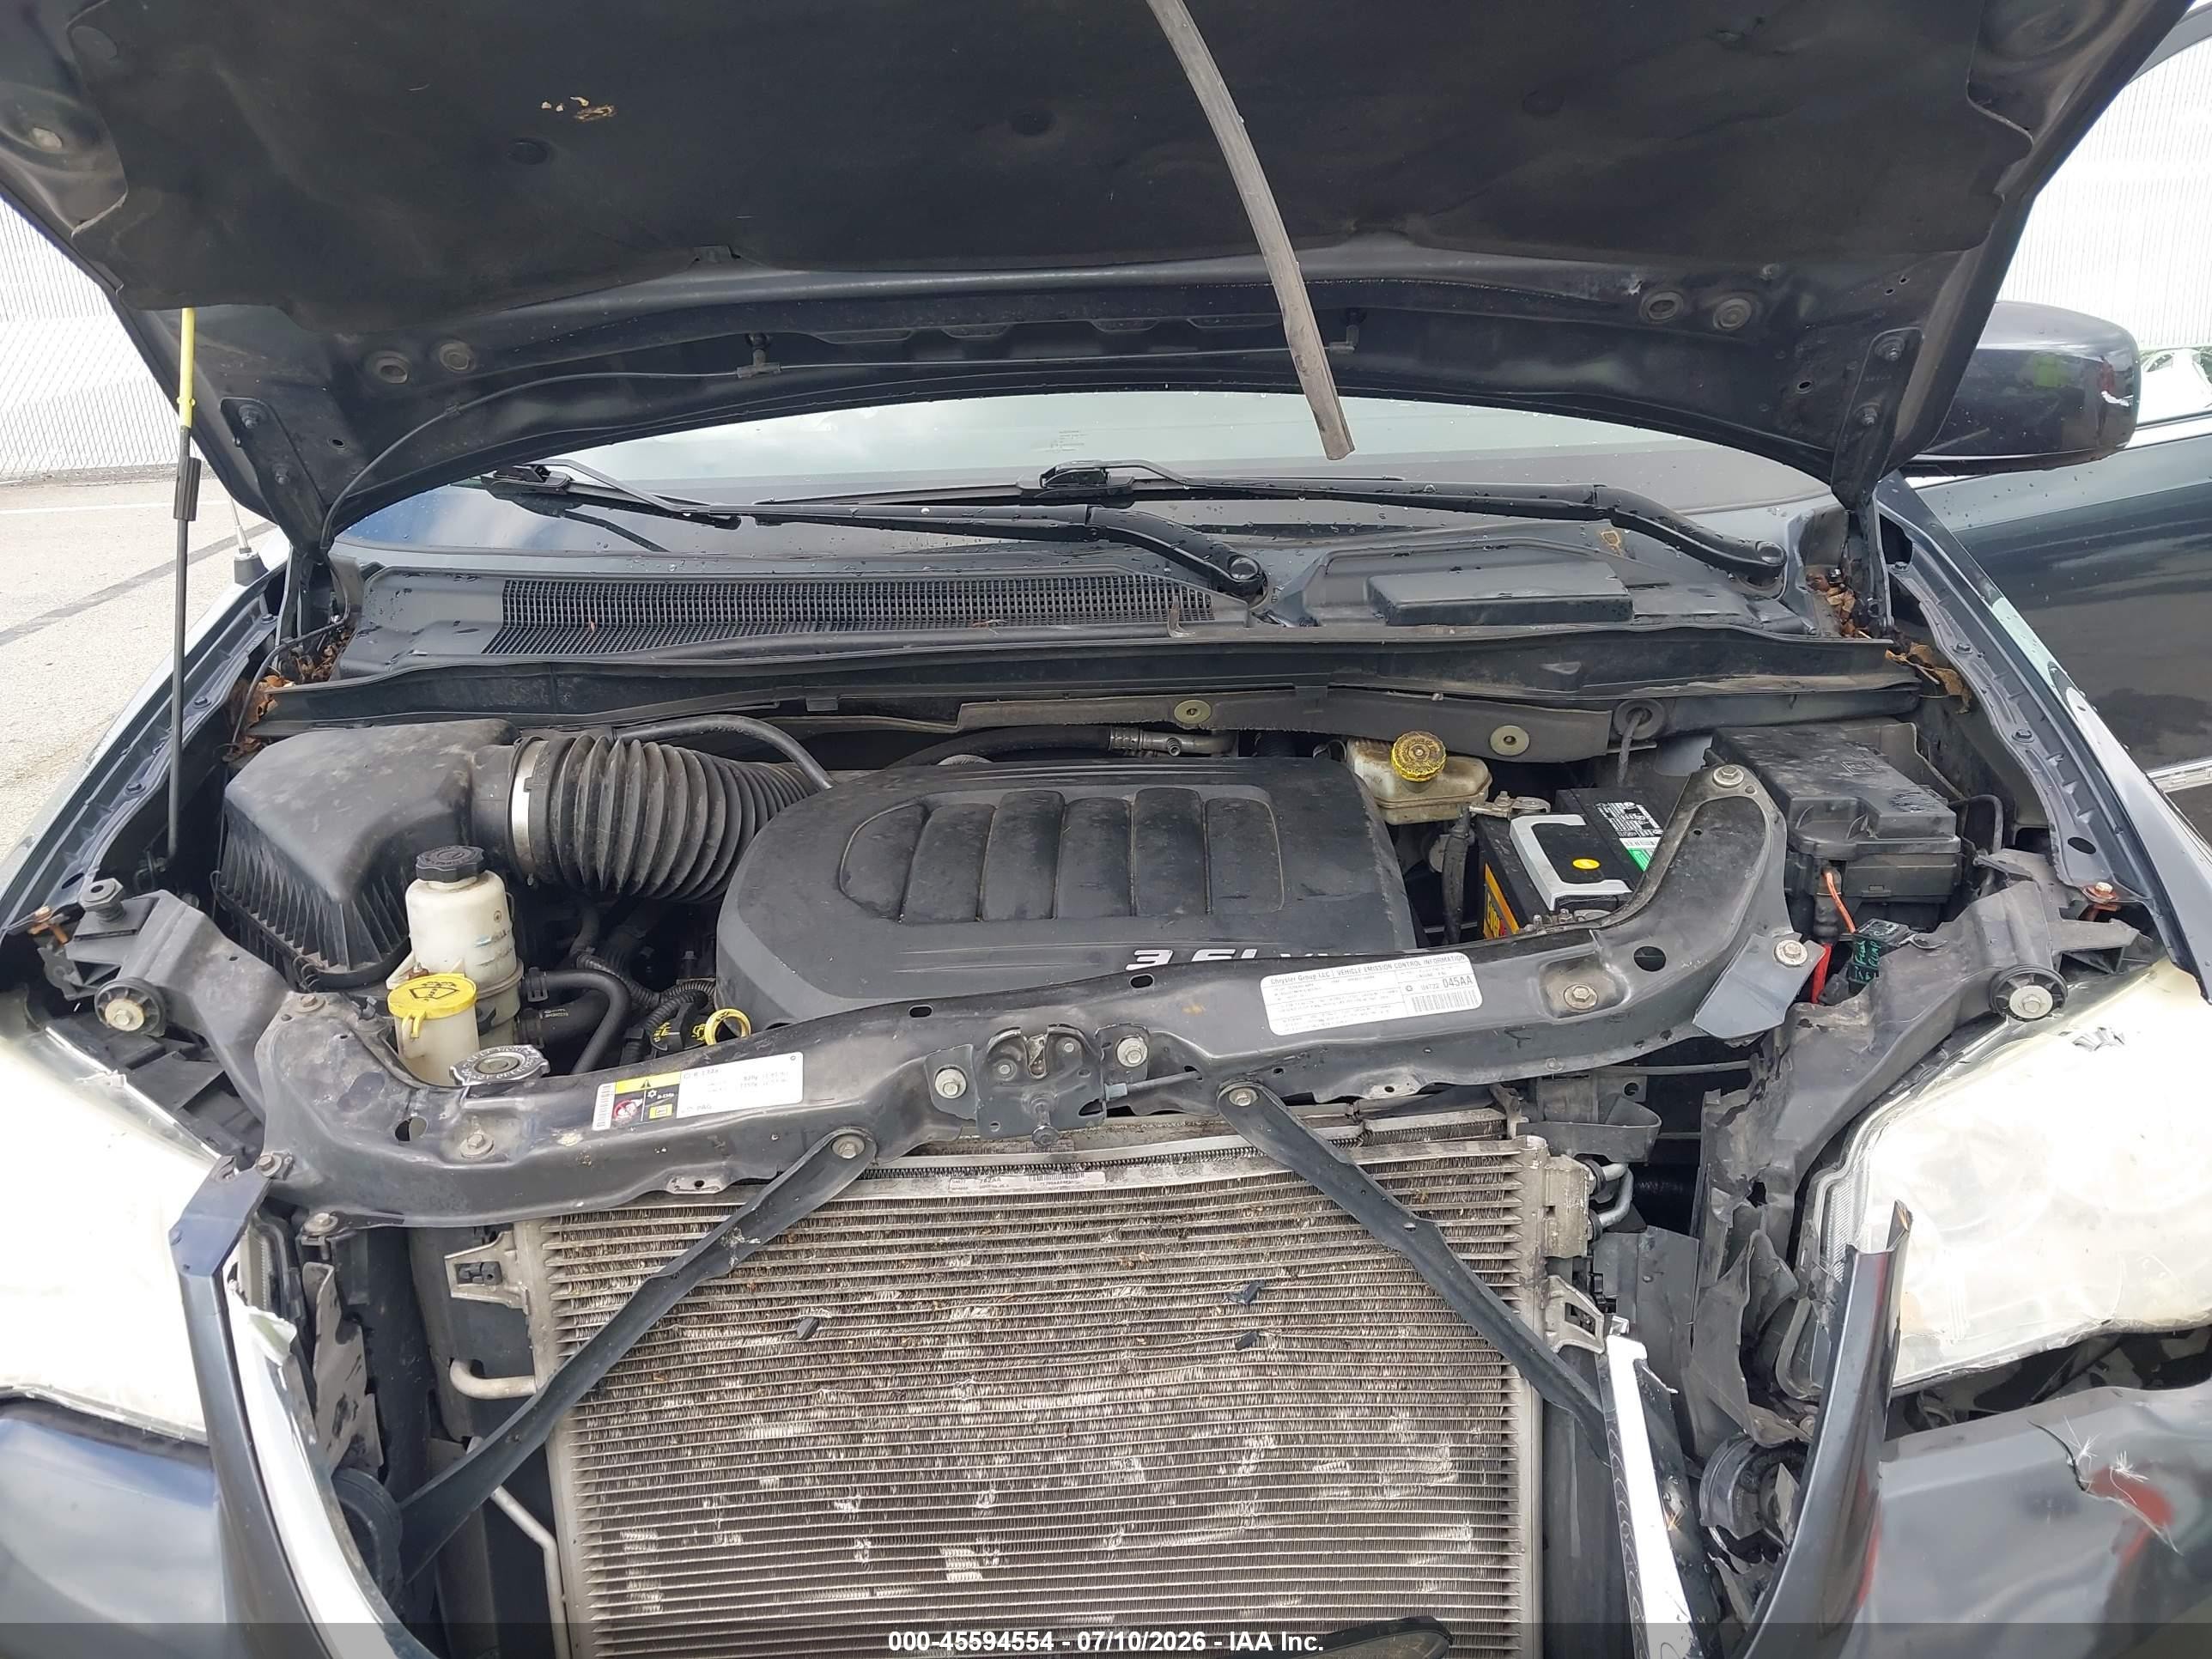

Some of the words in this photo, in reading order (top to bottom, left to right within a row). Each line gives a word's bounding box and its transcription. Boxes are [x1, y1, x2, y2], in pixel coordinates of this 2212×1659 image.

[1271, 975, 1296, 985] Chrysler
[1297, 974, 1317, 983] Group
[1336, 967, 1363, 976] VEHICLE
[1363, 963, 1394, 973] EMISSION
[1394, 960, 1421, 969] CONTROL
[1423, 954, 1467, 965] INFORMATION
[1442, 975, 1474, 988] 045AA
